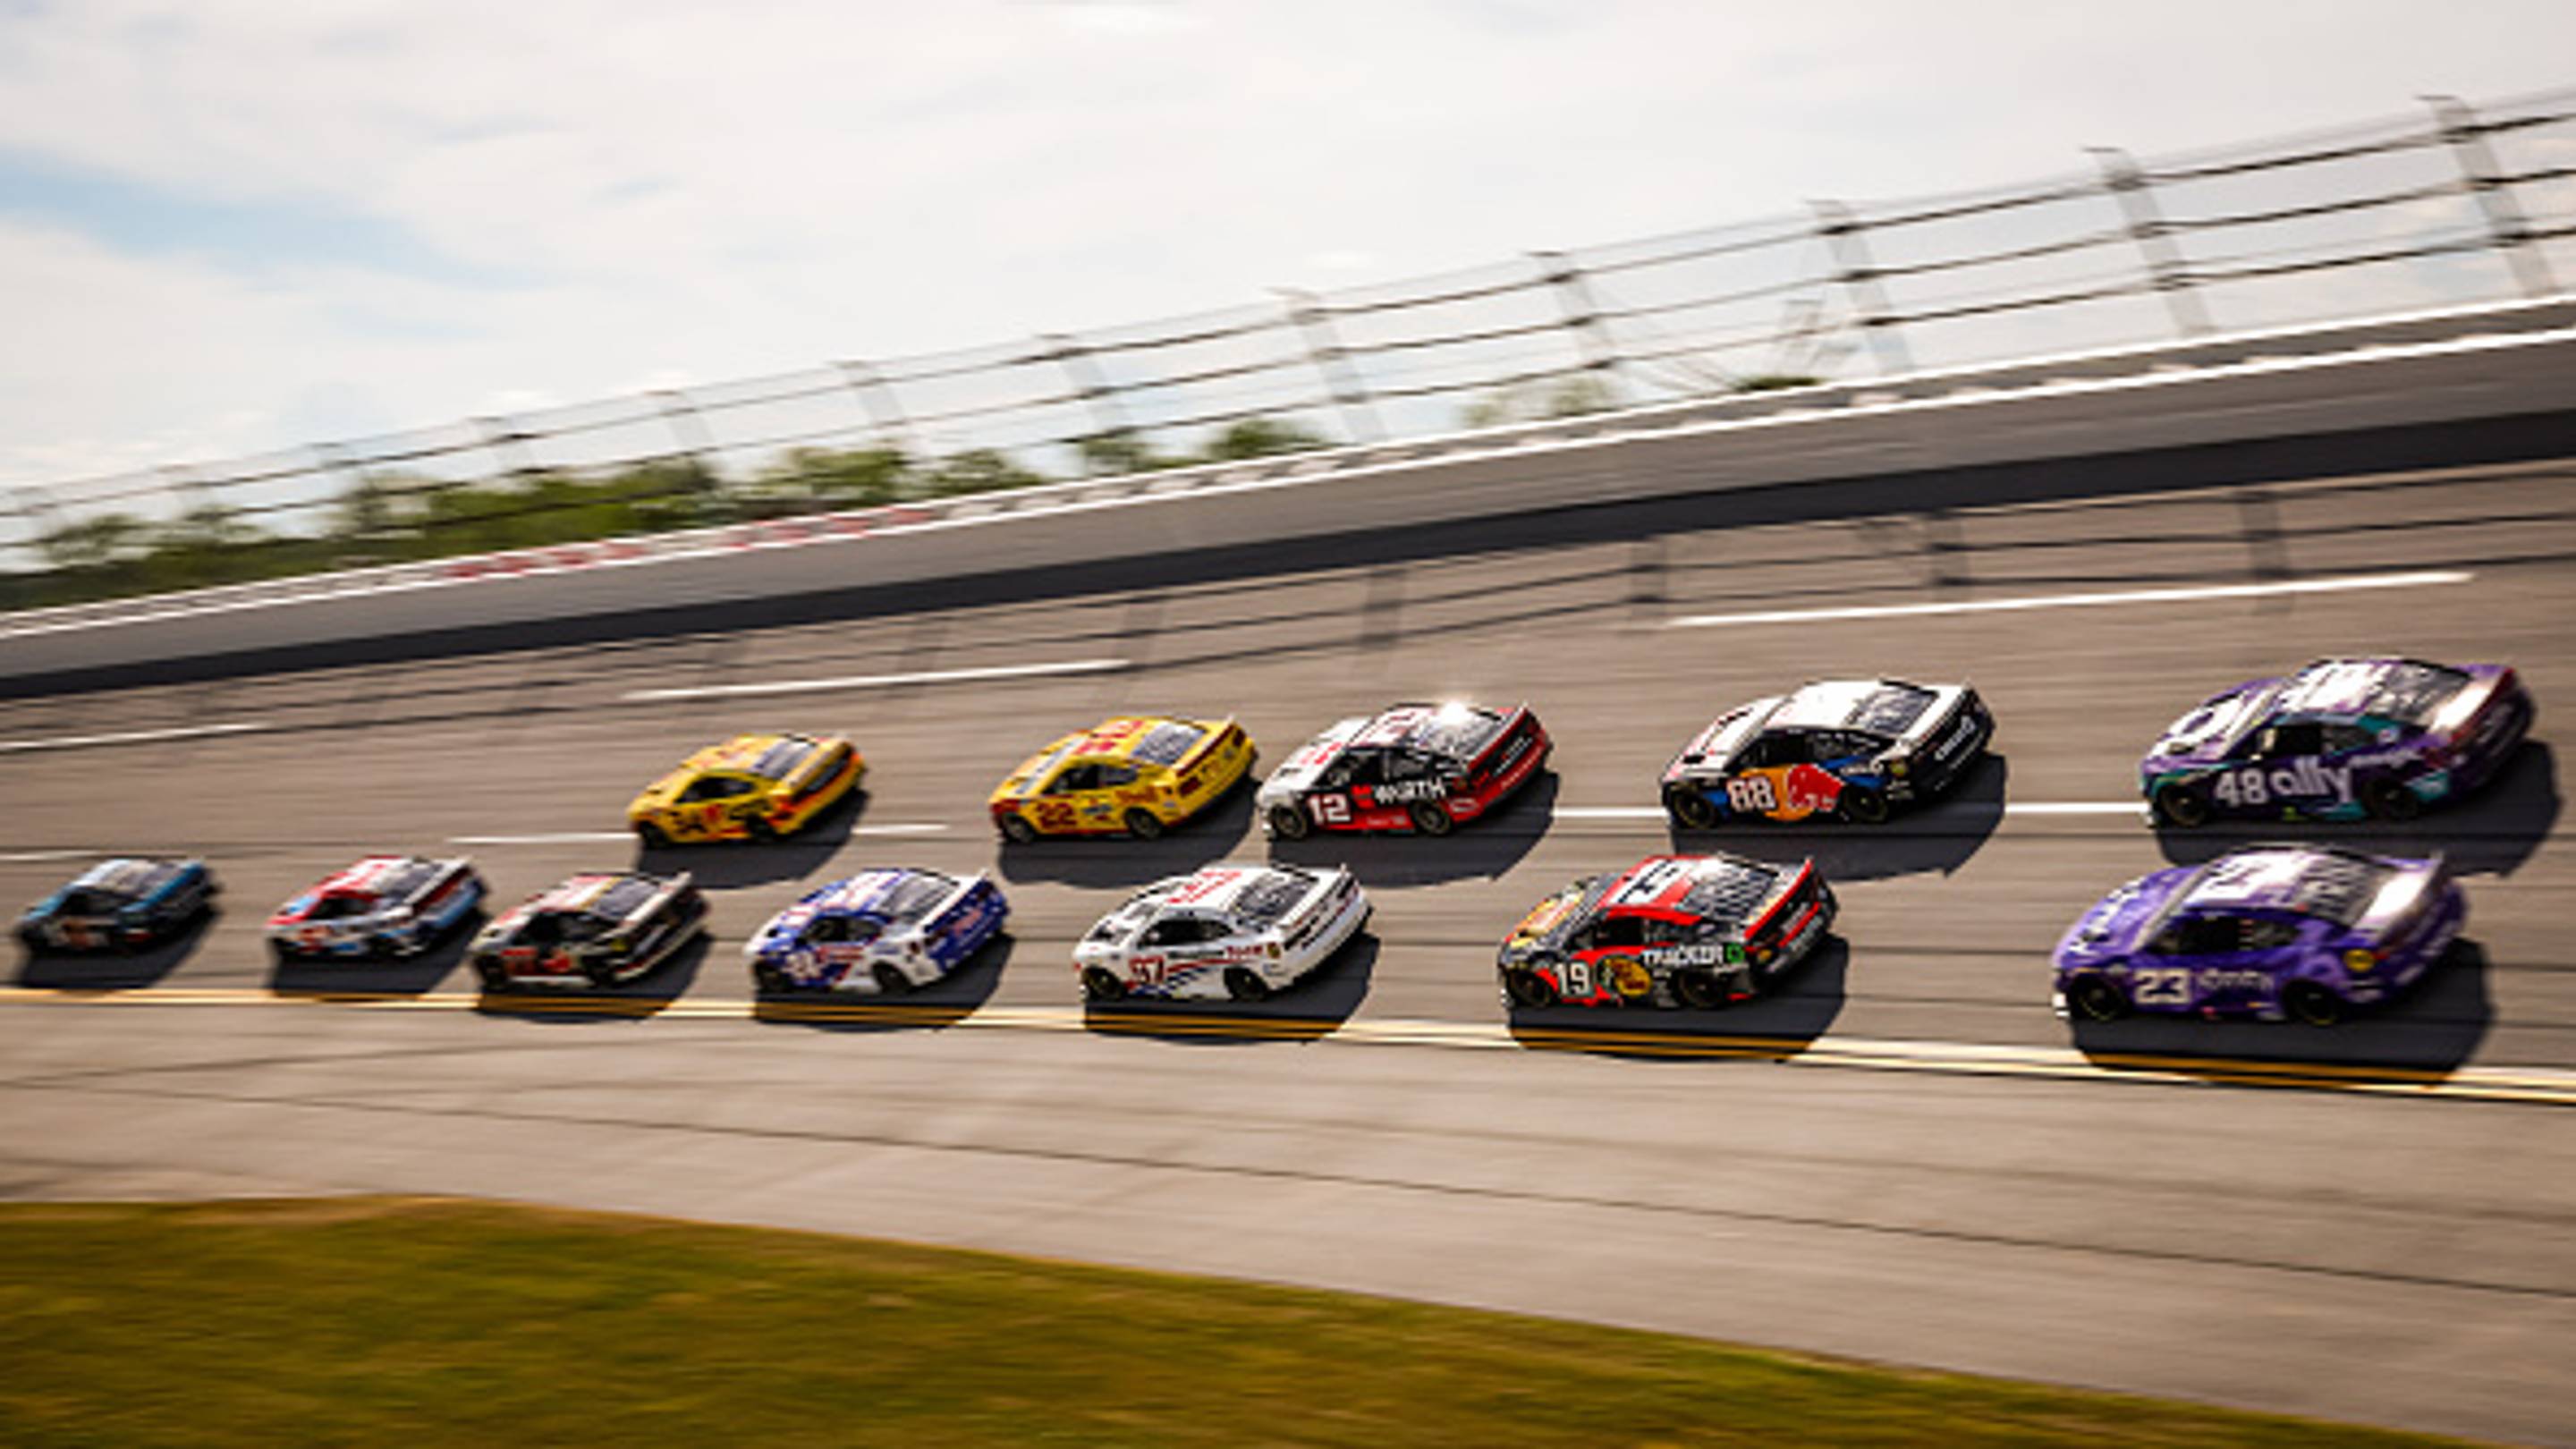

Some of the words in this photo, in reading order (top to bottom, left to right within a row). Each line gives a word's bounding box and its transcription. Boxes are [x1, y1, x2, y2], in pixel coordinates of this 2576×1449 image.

[1726, 776, 1776, 811] 88
[2216, 768, 2269, 806] 48
[2270, 755, 2352, 803] ally
[1036, 802, 1078, 828] 22
[1309, 793, 1352, 825] 12
[1555, 962, 1591, 996] 19
[2134, 969, 2190, 1004] 23
